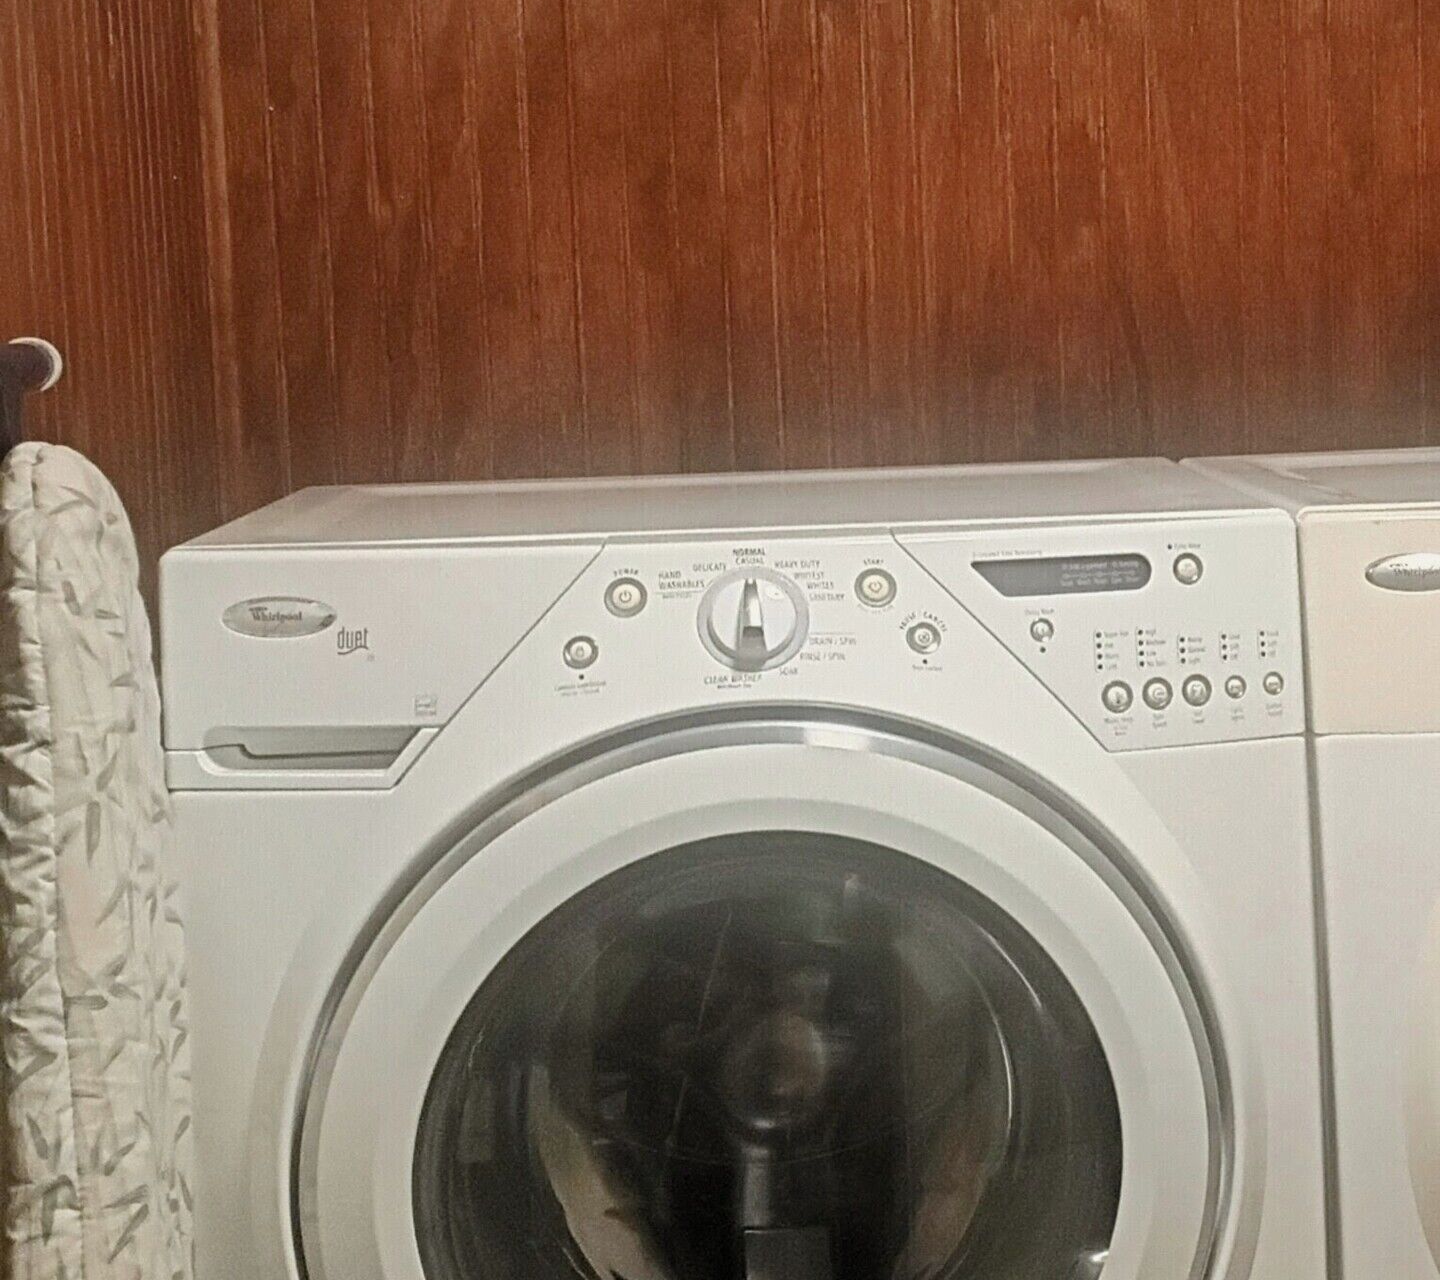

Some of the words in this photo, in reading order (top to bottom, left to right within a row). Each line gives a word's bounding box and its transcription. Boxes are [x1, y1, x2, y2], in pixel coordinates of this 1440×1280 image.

[733, 548, 765, 556] NORMAL
[801, 560, 821, 568] DUTY
[251, 610, 303, 623] Whirlpool
[337, 626, 369, 655] duet
